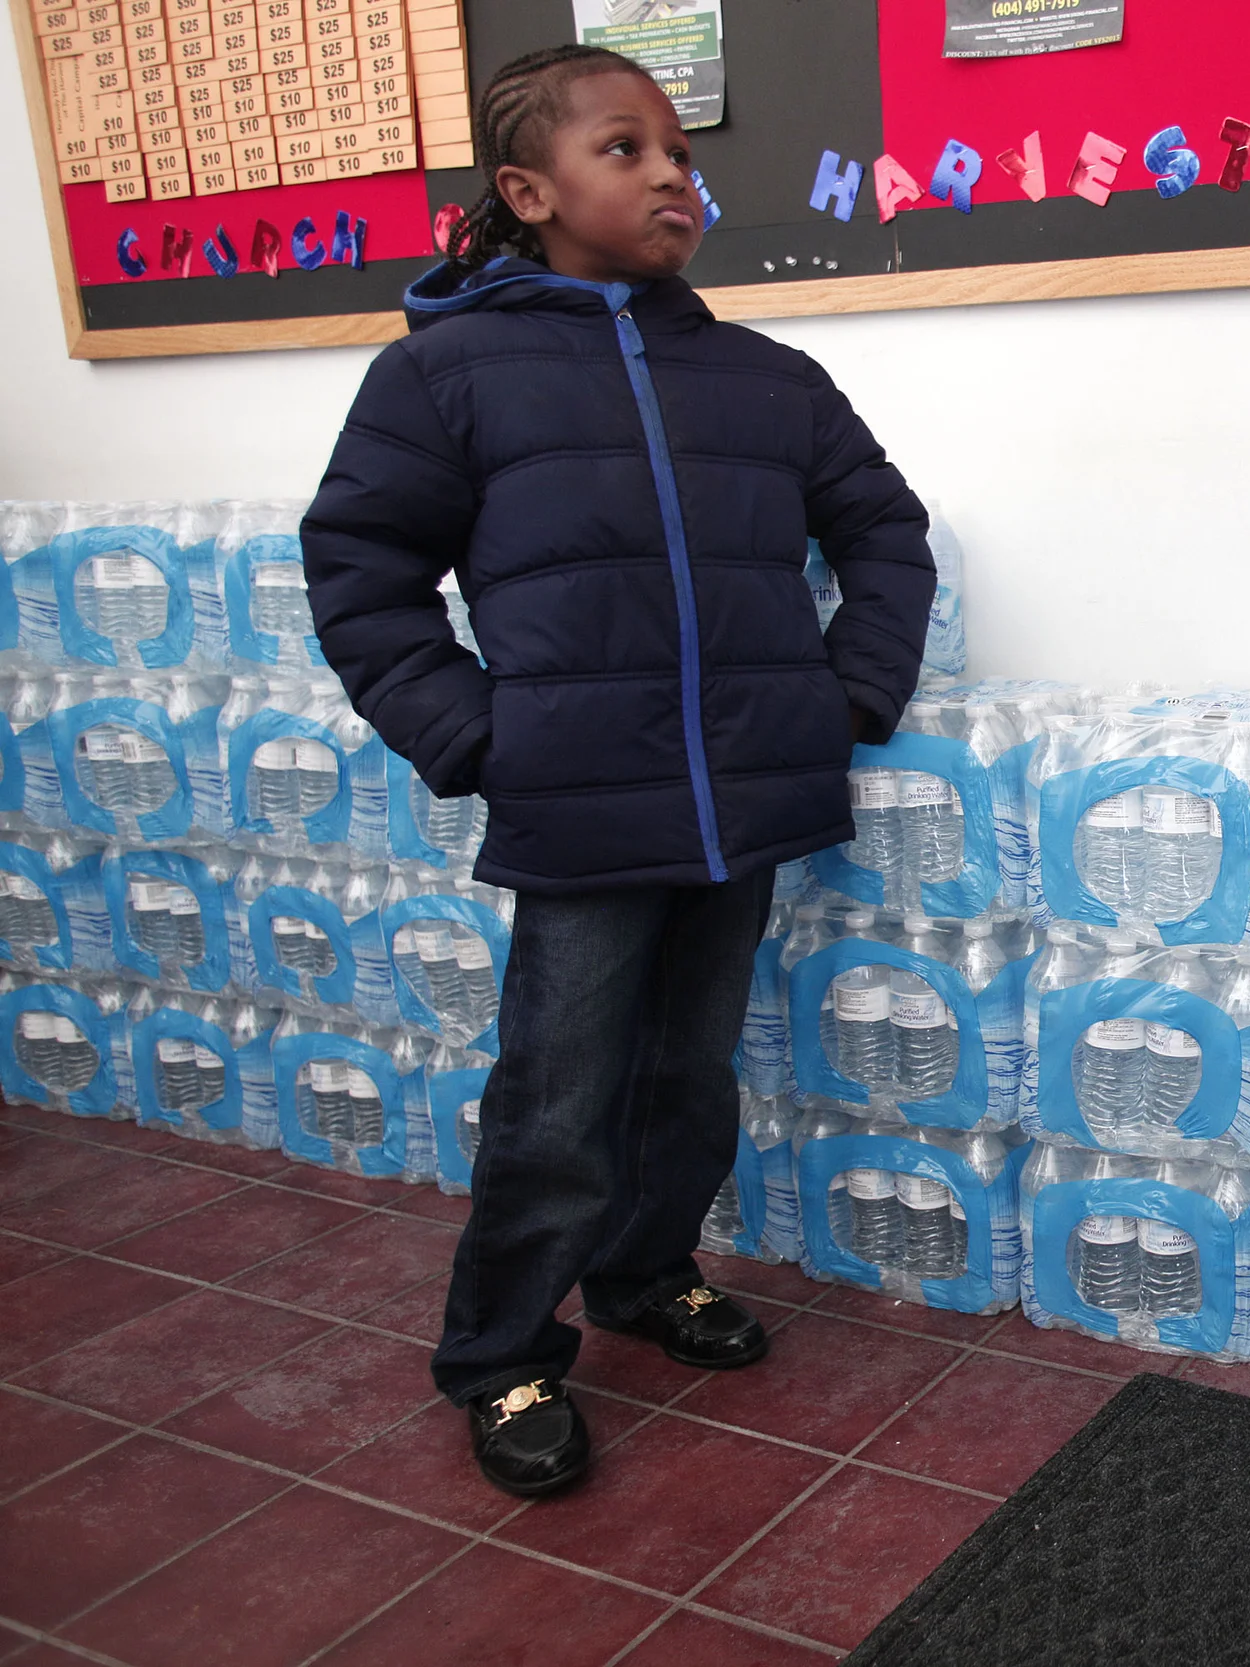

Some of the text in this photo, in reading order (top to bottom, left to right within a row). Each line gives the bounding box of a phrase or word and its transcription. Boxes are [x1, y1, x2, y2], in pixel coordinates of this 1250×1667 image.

[131, 2, 150, 17] $50
[268, 2, 290, 19] $25
[316, 0, 337, 12] $25
[992, 1, 1023, 18] (404)
[47, 14, 67, 28] $50
[89, 8, 108, 24] $50
[223, 11, 244, 27] $25
[367, 11, 388, 28] $25
[669, 16, 697, 27] OFFERED
[135, 25, 154, 40] $25
[180, 19, 199, 34] $25
[270, 26, 291, 42] $25
[318, 19, 339, 35] $25
[52, 37, 72, 52] $25
[92, 30, 111, 45] $25
[225, 35, 246, 50] $25
[369, 33, 391, 50] $25
[138, 47, 157, 62] $25
[183, 42, 202, 57] $25
[321, 42, 342, 58] $25
[95, 52, 114, 67] $25
[228, 57, 248, 73] $25
[273, 50, 294, 66] $25
[373, 56, 394, 73] $25
[142, 68, 161, 83] $25
[186, 64, 206, 79] $25
[277, 70, 299, 86] $25
[323, 64, 345, 79] $25
[677, 66, 695, 78] CPA
[99, 74, 118, 89] $25
[232, 78, 252, 94] $25
[374, 78, 395, 95] $10
[662, 81, 690, 96] -7919
[145, 90, 164, 105] $25
[190, 88, 209, 103] $25
[280, 92, 301, 108] $10
[327, 85, 348, 101] $10
[193, 105, 212, 120] $10
[235, 99, 254, 114] $10
[377, 97, 398, 114] $10
[148, 111, 167, 126] $10
[285, 113, 306, 129] $10
[330, 107, 351, 122] $10
[103, 117, 123, 132] $10
[239, 118, 259, 134] $10
[151, 131, 171, 146] $10
[196, 127, 216, 142] $10
[335, 134, 357, 149] $10
[378, 126, 400, 142] $10
[67, 141, 86, 155] $10
[108, 134, 127, 150] $10
[290, 141, 310, 156] $10
[201, 152, 221, 167] $10
[244, 147, 264, 162] $10
[382, 150, 404, 166] $10
[112, 159, 131, 173] $10
[157, 156, 176, 170] $10
[293, 163, 314, 178] $10
[338, 157, 360, 172] $10
[71, 164, 91, 178] $10
[248, 168, 267, 183] $10
[161, 179, 180, 194] $10
[205, 174, 225, 189] $10
[116, 182, 135, 197] $10
[116, 210, 367, 279] CHURCH
[907, 792, 932, 801] Drinking
[916, 785, 940, 794] Purified
